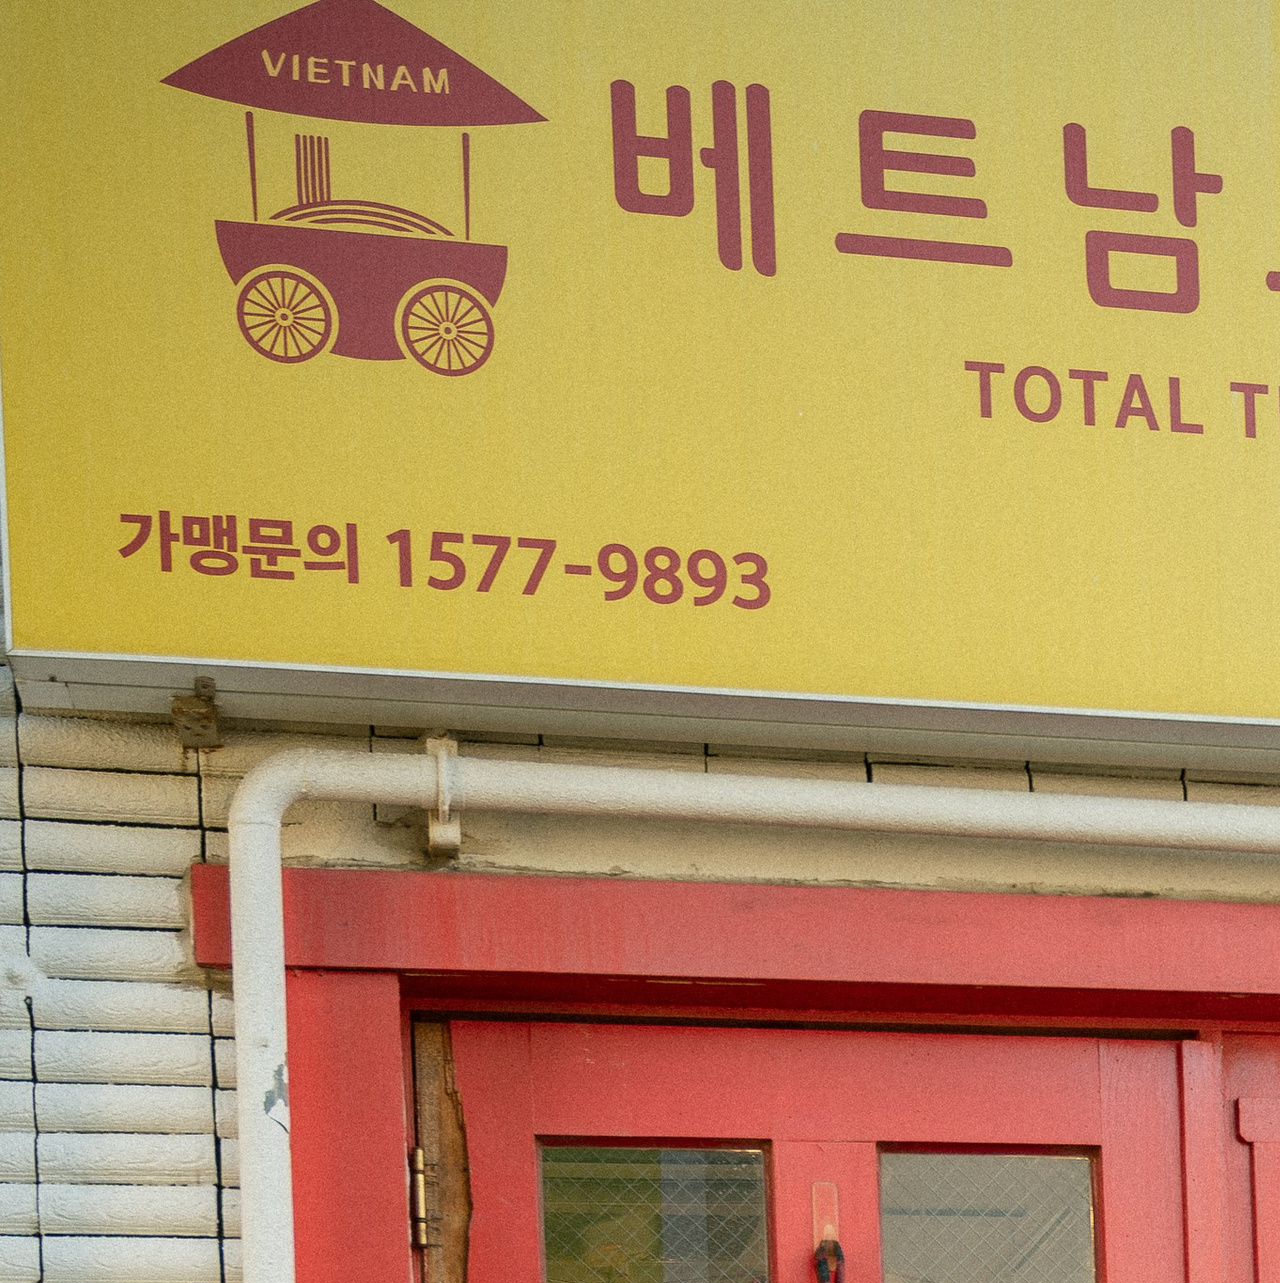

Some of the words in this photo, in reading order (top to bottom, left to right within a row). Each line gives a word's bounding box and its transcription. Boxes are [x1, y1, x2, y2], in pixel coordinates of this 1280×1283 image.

[261, 50, 451, 95] VIETNAM
[964, 360, 1204, 434] TOTAL
[119, 509, 360, 585] 가맹문의
[386, 529, 772, 611] 1577-9893
